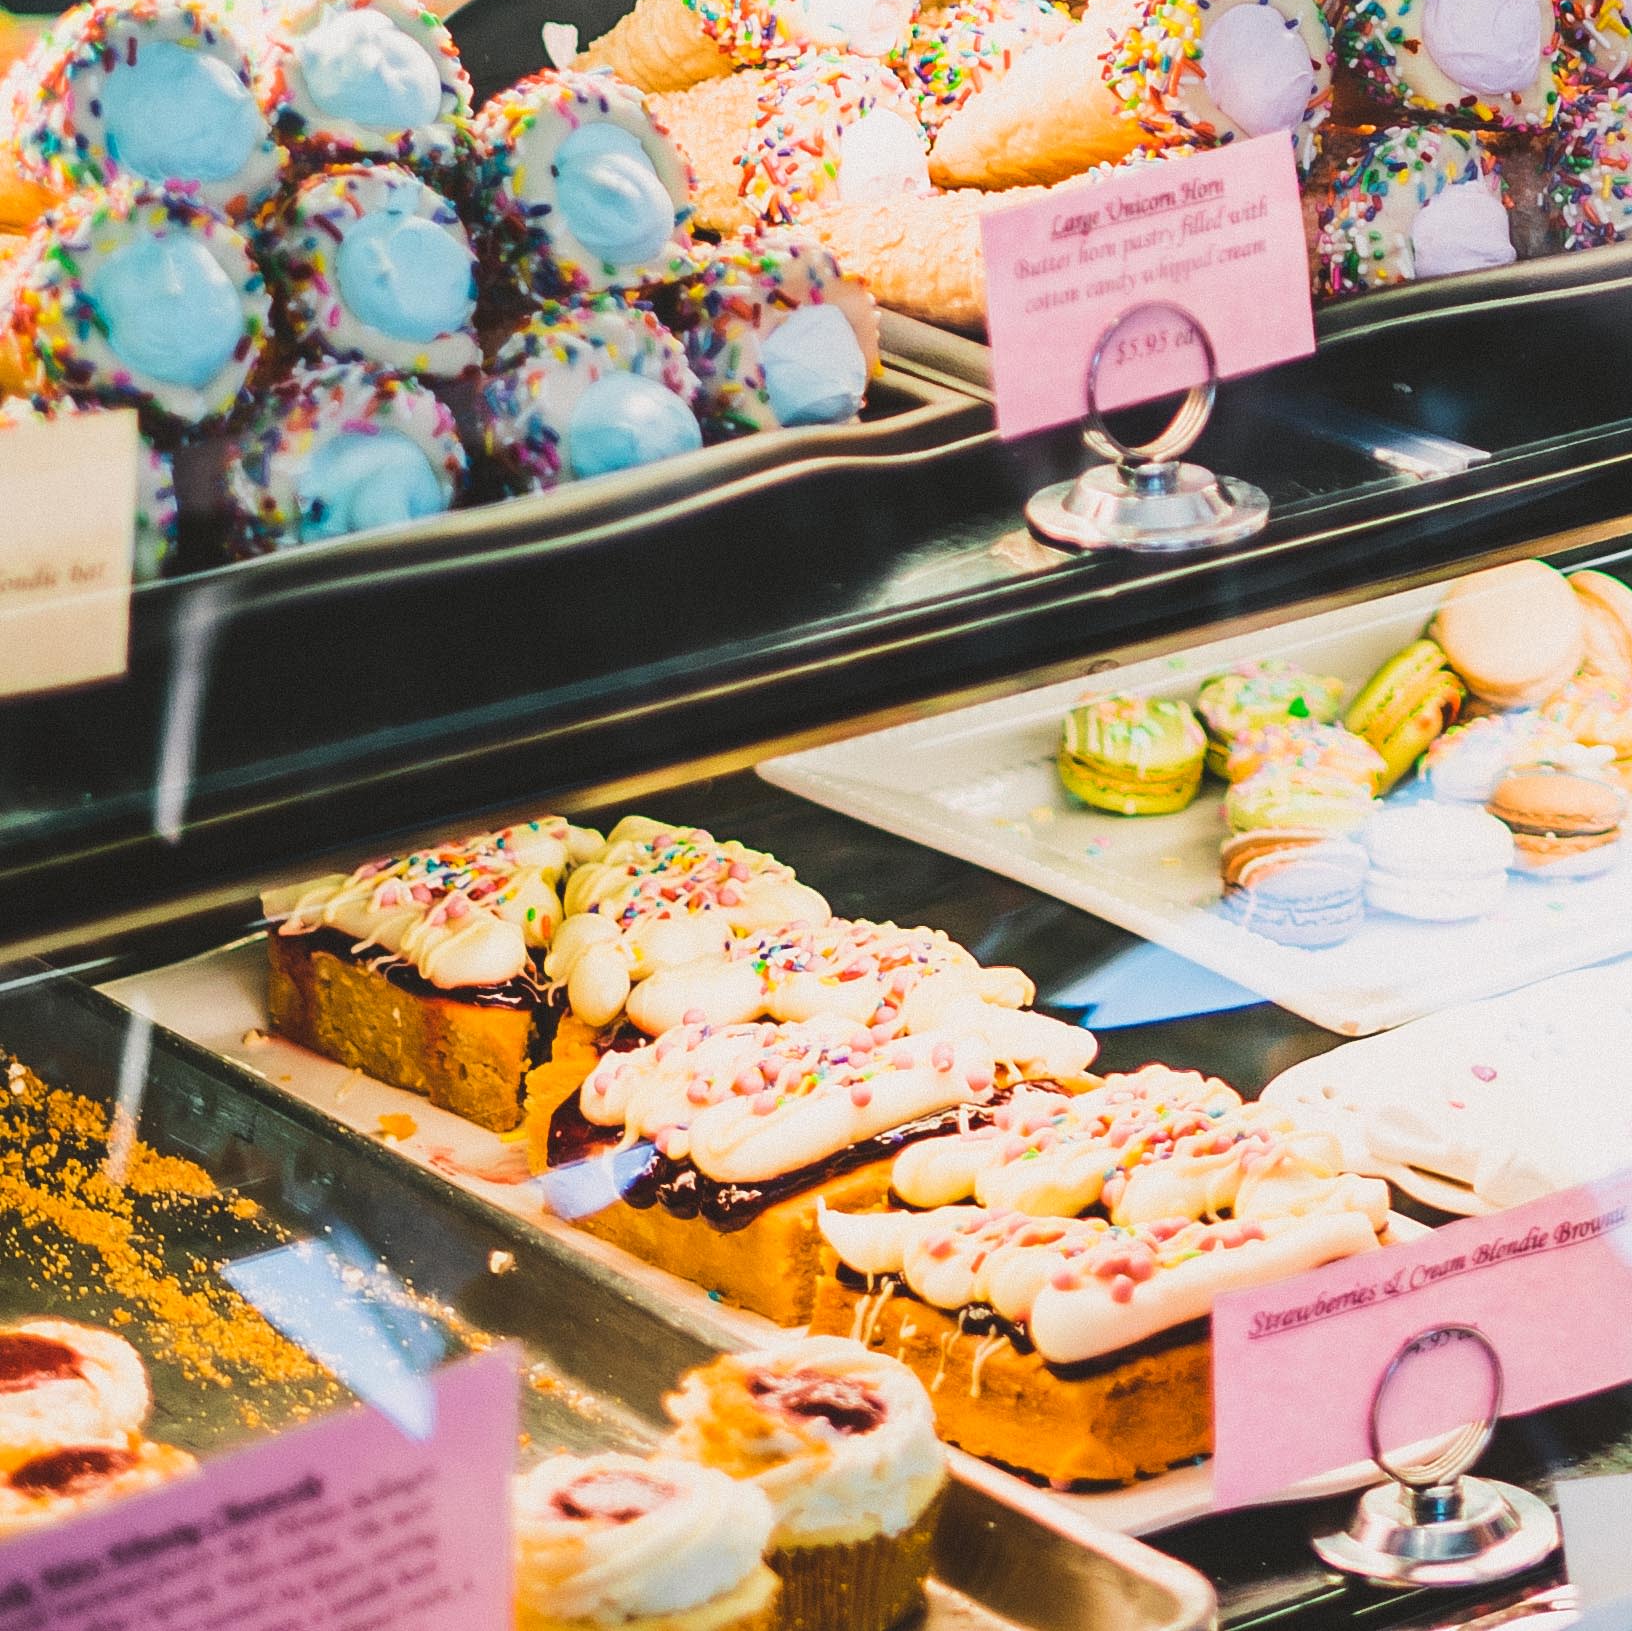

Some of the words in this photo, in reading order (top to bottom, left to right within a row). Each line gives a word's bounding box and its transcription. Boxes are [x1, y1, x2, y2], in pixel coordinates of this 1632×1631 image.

[1051, 208, 1102, 238] Large
[1104, 190, 1176, 225] Unicorn
[1178, 176, 1226, 209] Horn
[1077, 239, 1117, 267] horn
[1122, 225, 1176, 262] pastry
[1179, 210, 1225, 249] filled
[1230, 198, 1269, 230] with
[1025, 286, 1079, 315] cotton
[1086, 273, 1138, 306] candy
[1142, 251, 1214, 292] whipped
[1217, 241, 1268, 265] cream
[1115, 332, 1170, 367] $5.95
[1249, 1282, 1378, 1335] Strawberries
[1383, 1270, 1405, 1294] &
[1409, 1255, 1467, 1291] Cream
[1472, 1225, 1547, 1266] Blondie
